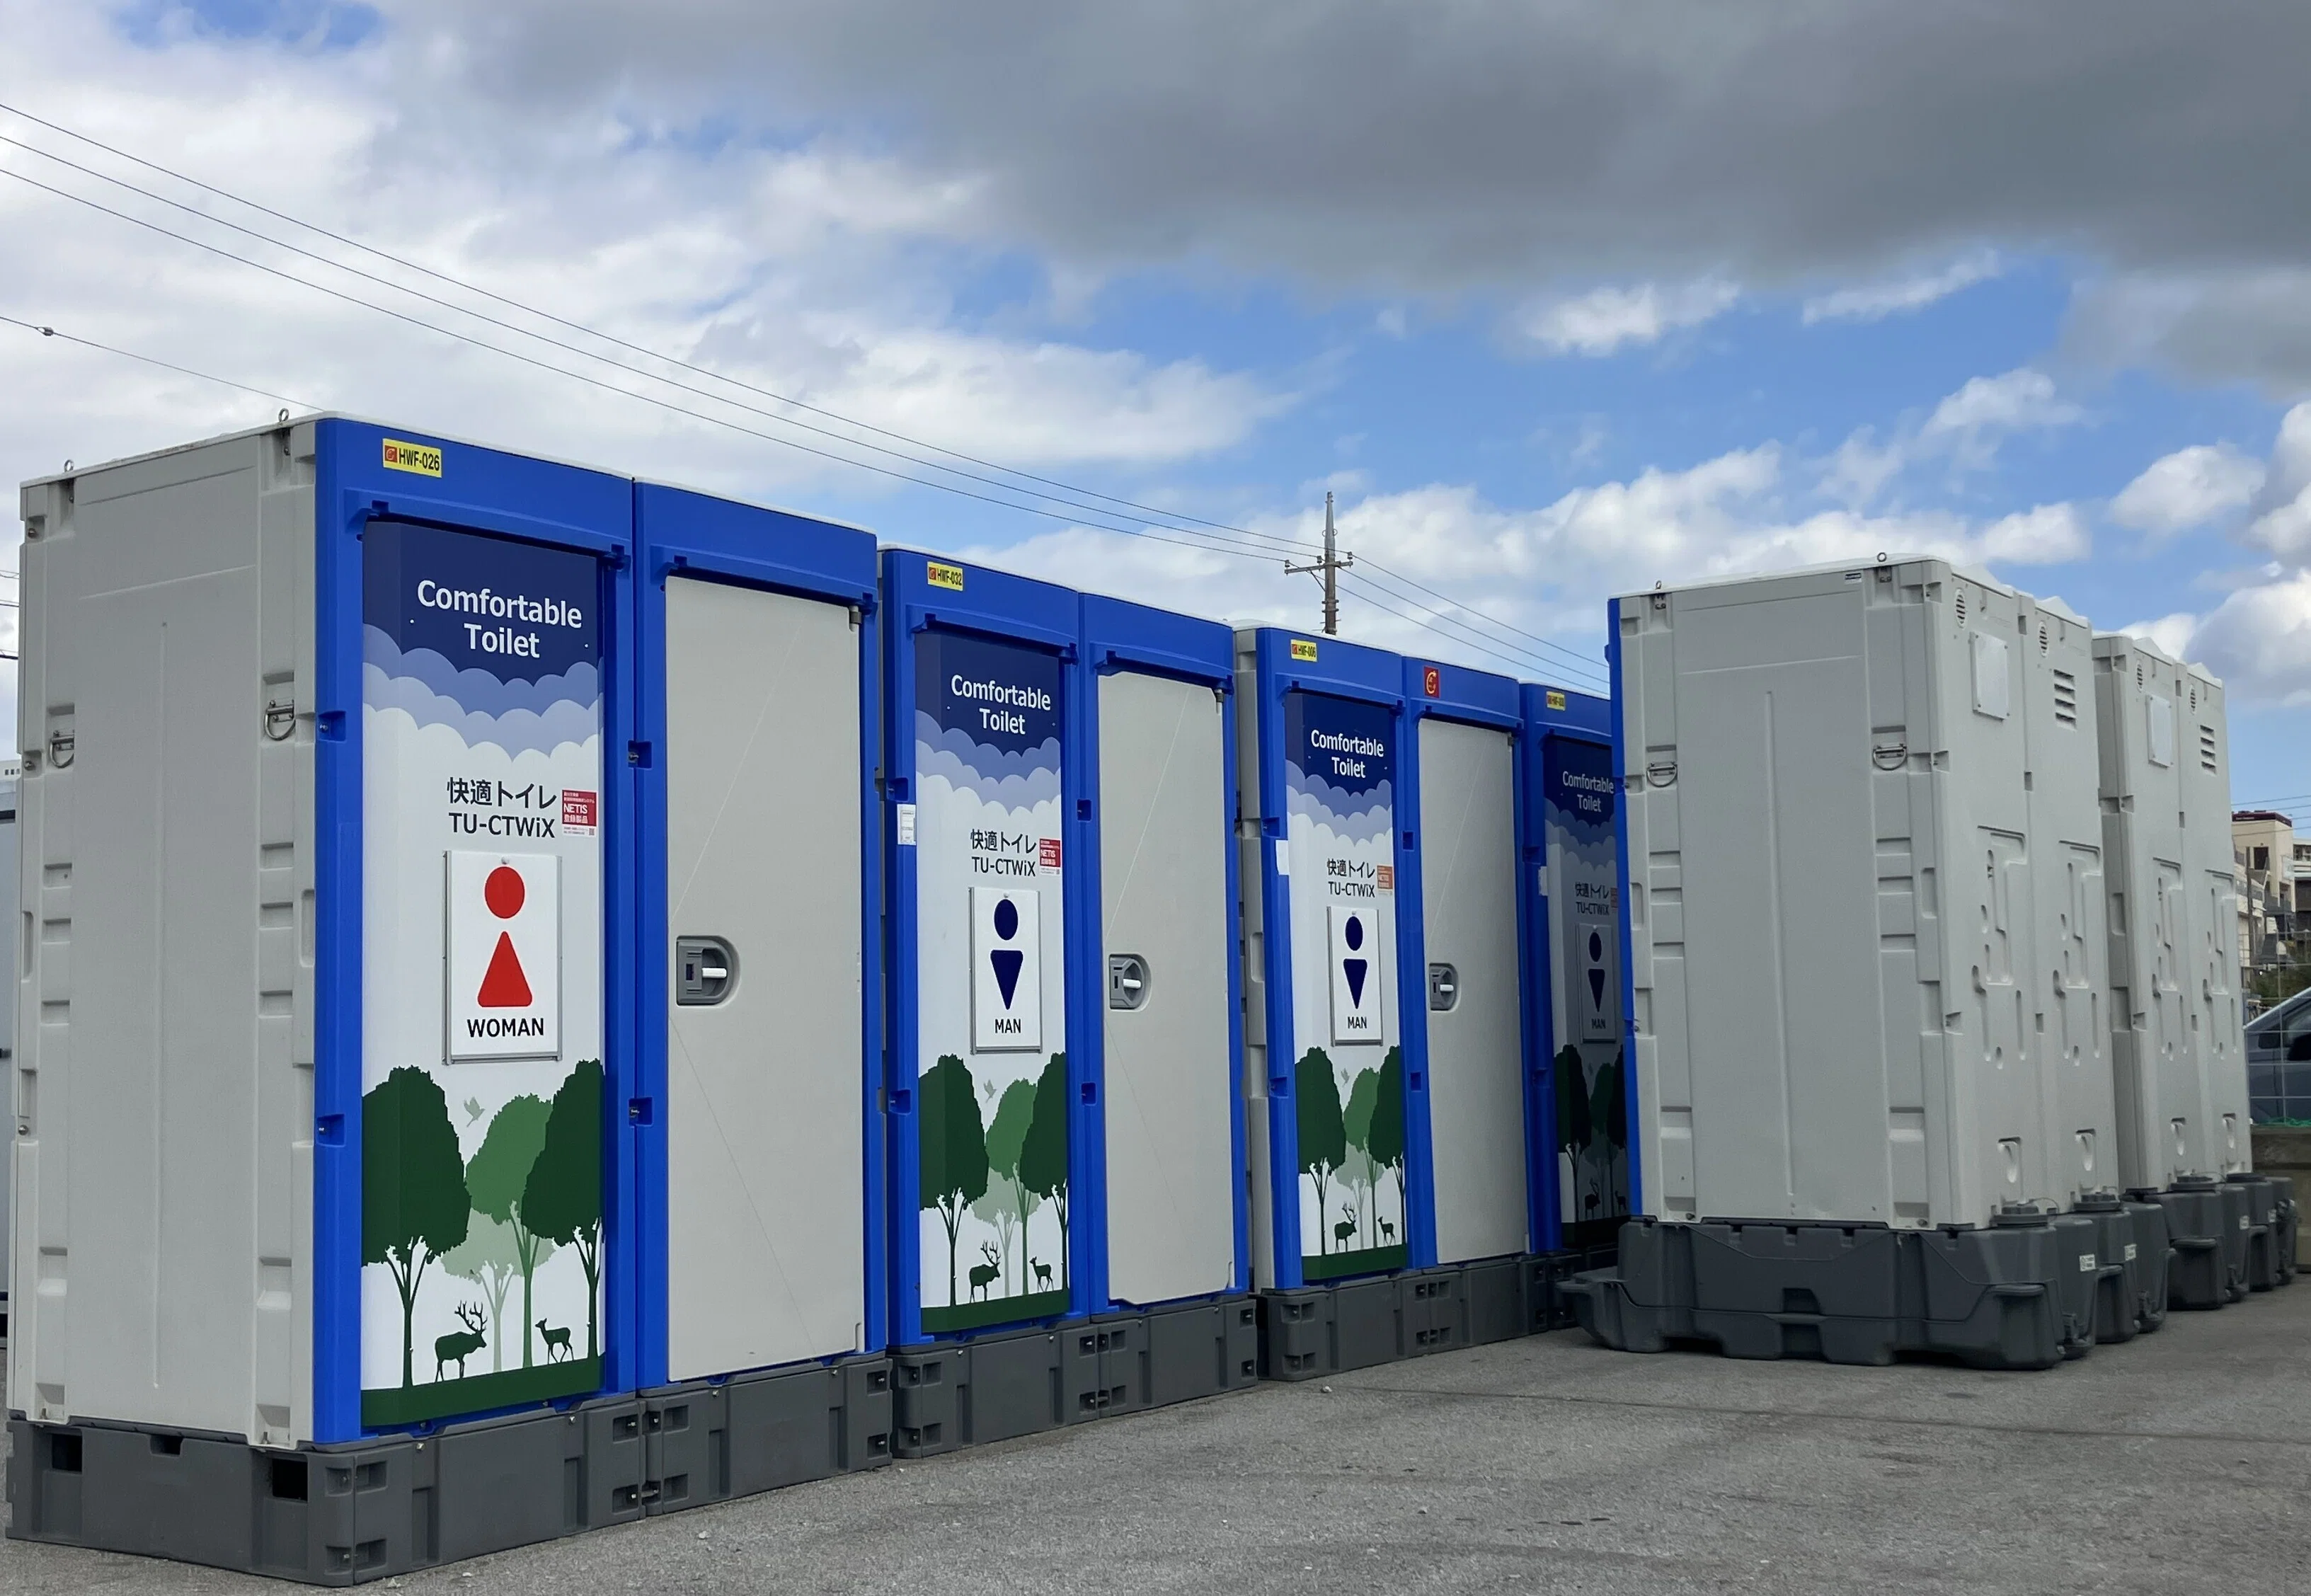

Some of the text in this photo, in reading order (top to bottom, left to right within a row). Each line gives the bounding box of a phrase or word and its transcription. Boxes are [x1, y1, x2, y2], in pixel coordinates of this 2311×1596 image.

[398, 447, 440, 471] HWF-026
[418, 580, 583, 628] Comfortable
[464, 623, 540, 658] Toilet
[951, 674, 1051, 711] Comfortable
[979, 708, 1026, 735] Toilet
[1311, 730, 1384, 757] Comfortable
[1331, 757, 1366, 779] Toilet
[447, 777, 558, 809] 快適トイレ
[1562, 771, 1614, 794] Comfortable
[563, 803, 588, 815] NETIS
[1577, 794, 1602, 813] Toilet
[448, 812, 556, 839] TU-CTWiX
[970, 829, 1037, 854] 快適トイレ
[971, 856, 1036, 877] TU-CTWiX
[1326, 858, 1375, 879] 快適トイレ
[1328, 881, 1375, 898] TU-CTWiX
[466, 1018, 544, 1038] WOMAN
[994, 1018, 1021, 1033] MAN
[1347, 1016, 1367, 1028] MAN
[1591, 1018, 1606, 1029] MAN
